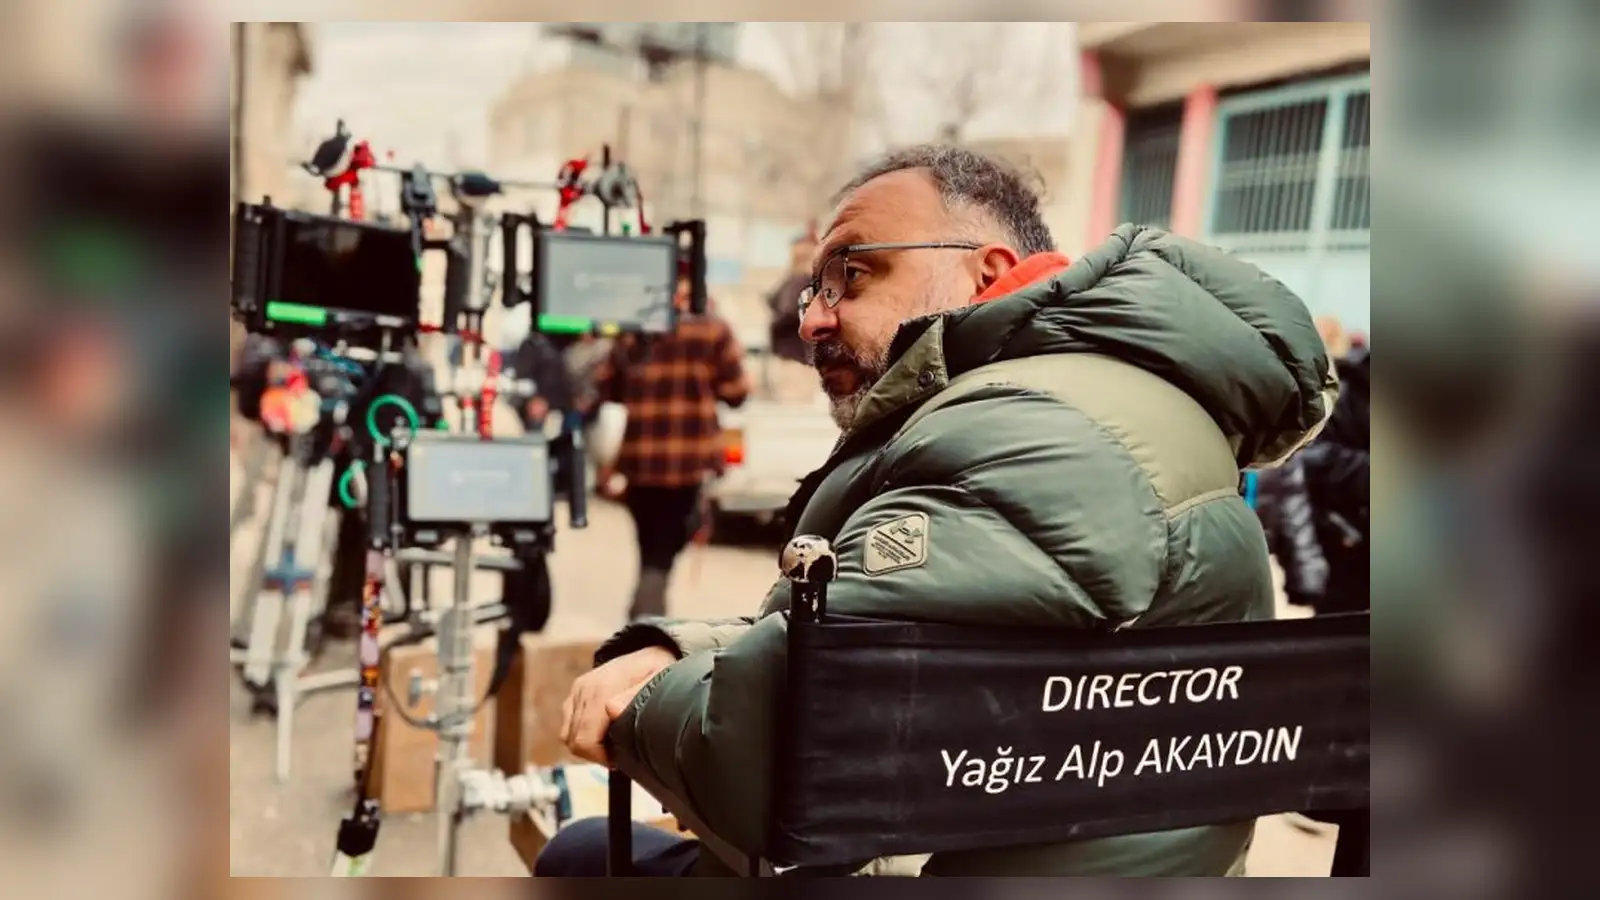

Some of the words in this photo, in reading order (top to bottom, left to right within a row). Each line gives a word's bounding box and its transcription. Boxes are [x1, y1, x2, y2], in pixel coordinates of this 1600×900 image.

[1042, 666, 1243, 712] DIRECTOR
[940, 746, 1046, 794] Yağız
[1055, 741, 1125, 788] Alp
[1134, 725, 1303, 776] AKAYDIN
